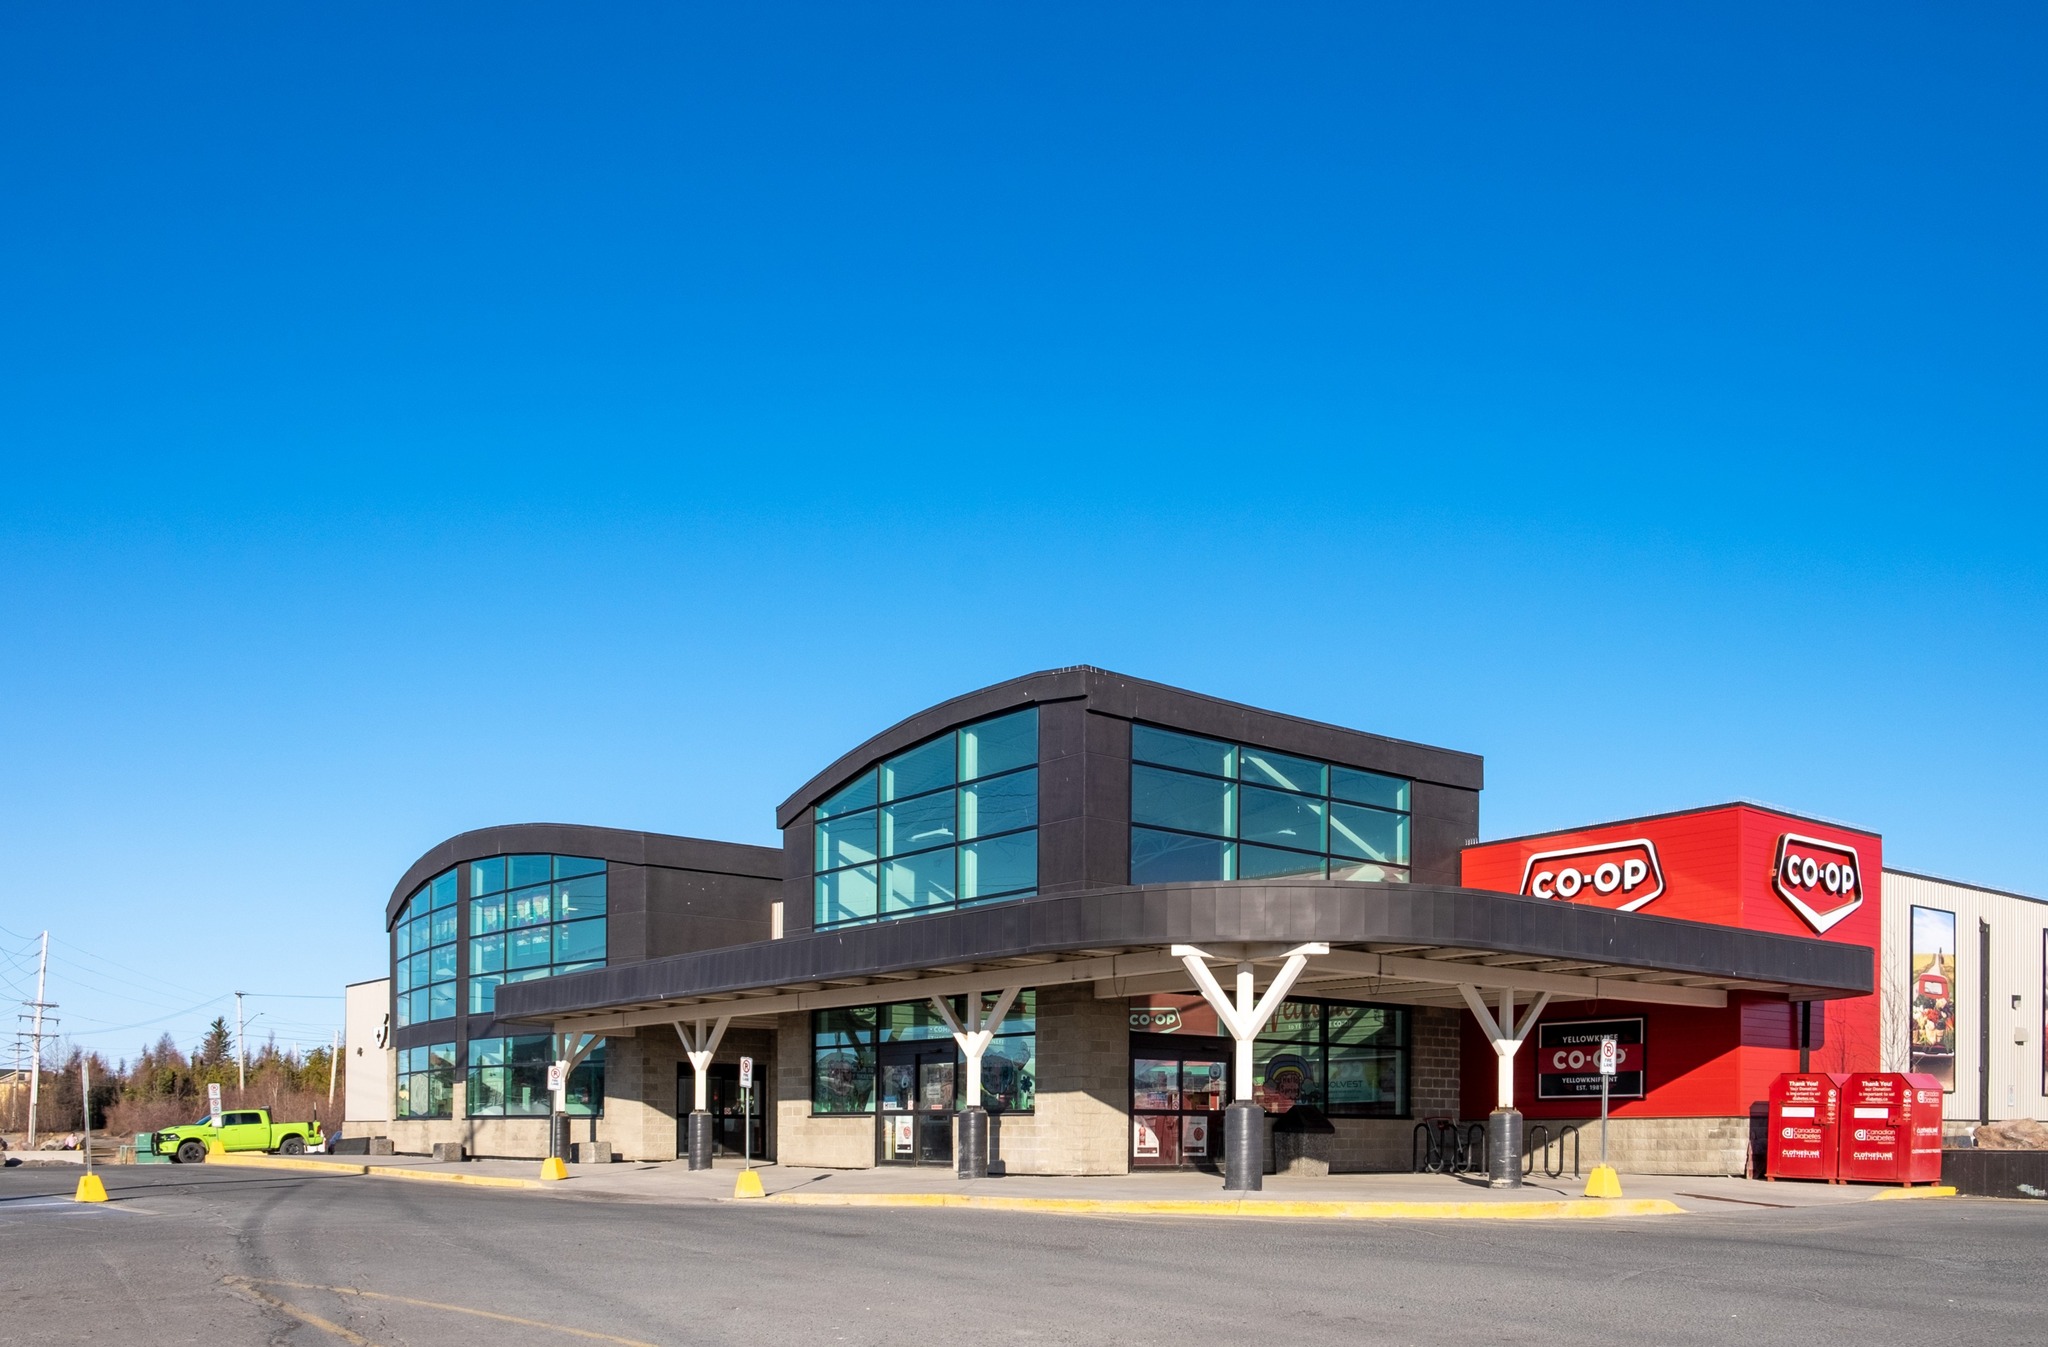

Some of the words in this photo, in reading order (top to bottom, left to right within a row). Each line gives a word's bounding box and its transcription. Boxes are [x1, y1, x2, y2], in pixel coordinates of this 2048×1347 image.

[1532, 859, 1648, 899] CO-OP
[1787, 854, 1855, 894] CO-OP
[1129, 1014, 1176, 1026] CO-OP
[1329, 1080, 1363, 1089] OLVEST
[1562, 1076, 1603, 1084] YELLOWKNIF
